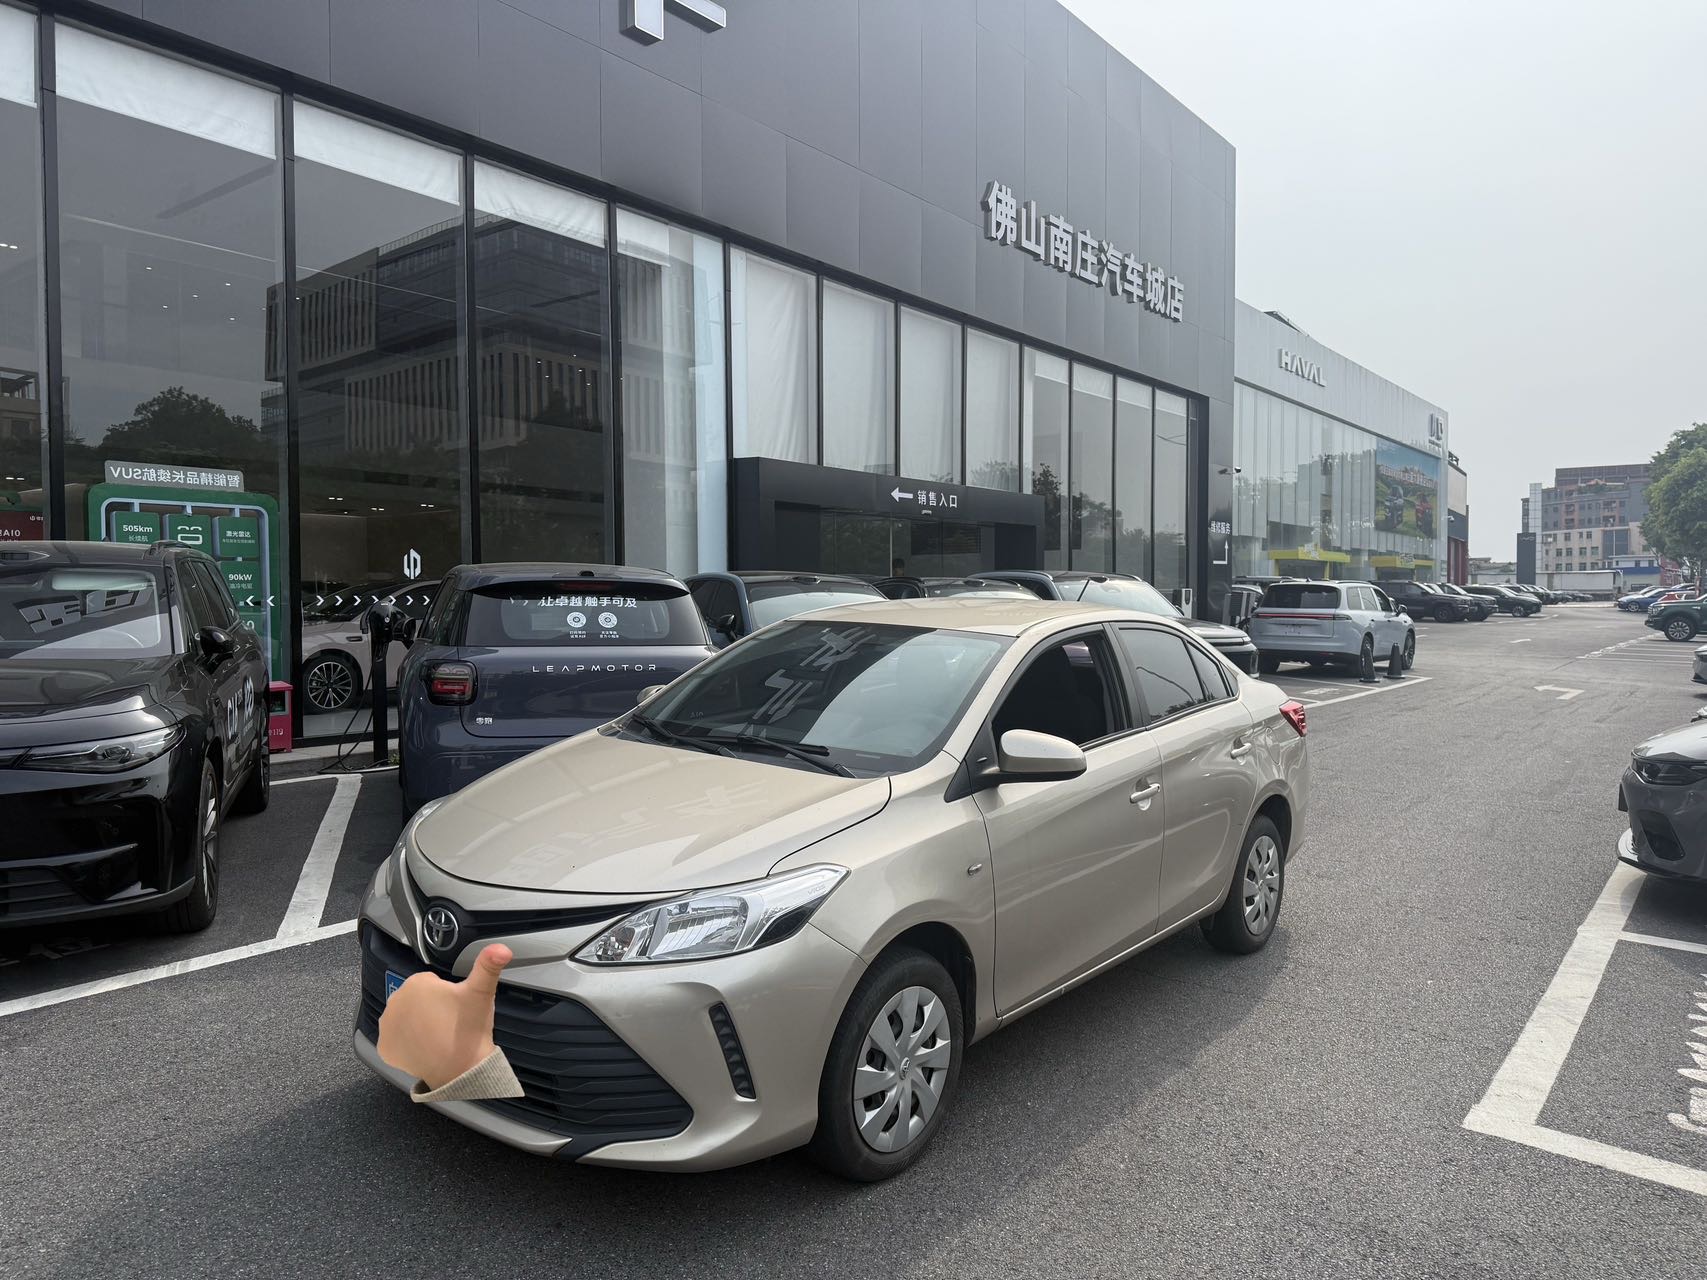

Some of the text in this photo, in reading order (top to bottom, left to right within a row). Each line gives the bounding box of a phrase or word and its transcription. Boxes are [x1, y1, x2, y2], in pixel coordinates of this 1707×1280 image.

[982, 180, 1185, 322] 佛山南庄汽车城店
[1279, 348, 1327, 387] HAVAL
[917, 490, 958, 508] 销售入口
[122, 524, 153, 533] 505km
[539, 596, 637, 608] 让卓越触手可及
[532, 664, 656, 672] LEAPMOTOR
